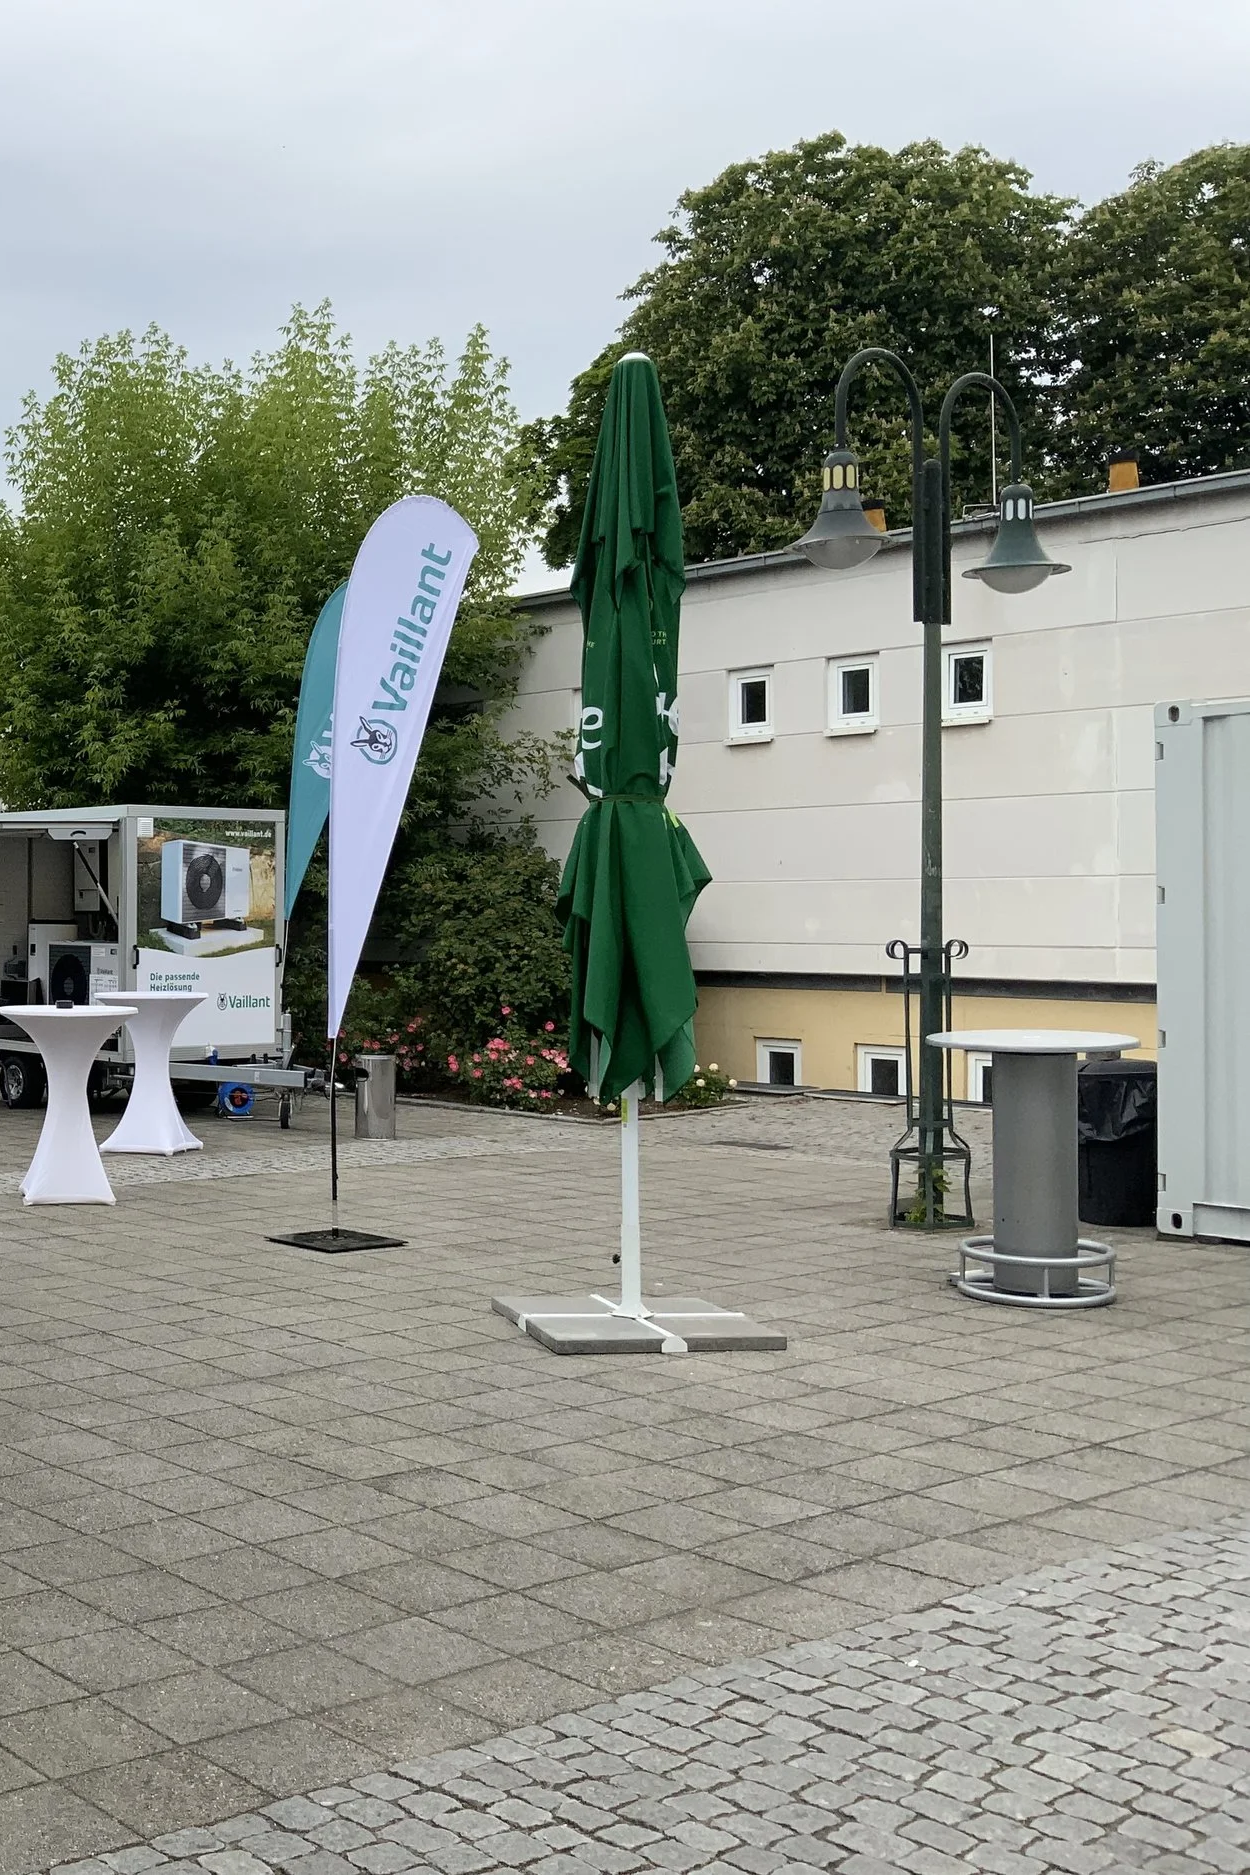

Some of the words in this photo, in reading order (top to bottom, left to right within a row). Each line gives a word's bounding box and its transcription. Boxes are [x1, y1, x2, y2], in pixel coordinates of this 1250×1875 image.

[371, 542, 452, 711] Vaillant
[225, 829, 272, 838] www.vaillant.de
[150, 972, 163, 981] Die
[165, 972, 200, 982] passende
[150, 983, 192, 992] Heizlösung
[229, 995, 270, 1008] Vaillant
